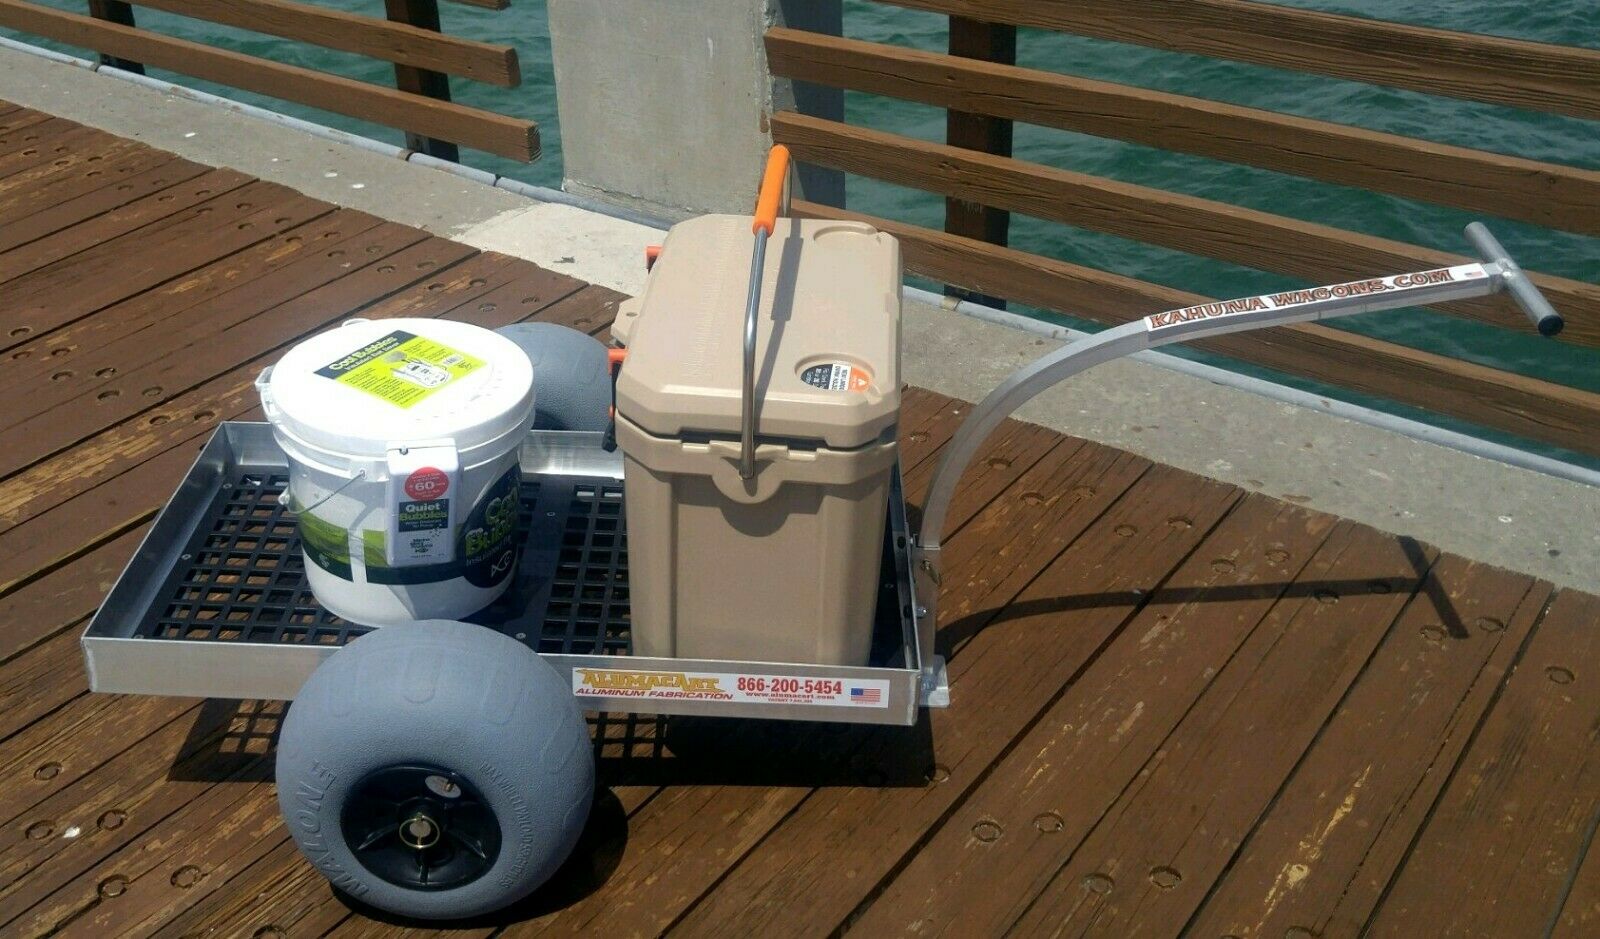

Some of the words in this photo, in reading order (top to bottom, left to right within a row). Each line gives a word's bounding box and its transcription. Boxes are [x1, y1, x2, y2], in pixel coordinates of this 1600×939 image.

[1150, 296, 1269, 328] KAHUNA
[415, 482, 435, 491] 60
[405, 503, 440, 513] Quiet
[400, 511, 448, 522] Bubbles
[737, 677, 842, 695] 866-200-5454
[576, 687, 645, 697] ALUMINUM
[648, 691, 733, 701] FABRICATION
[745, 691, 835, 700] www.alumacart.com
